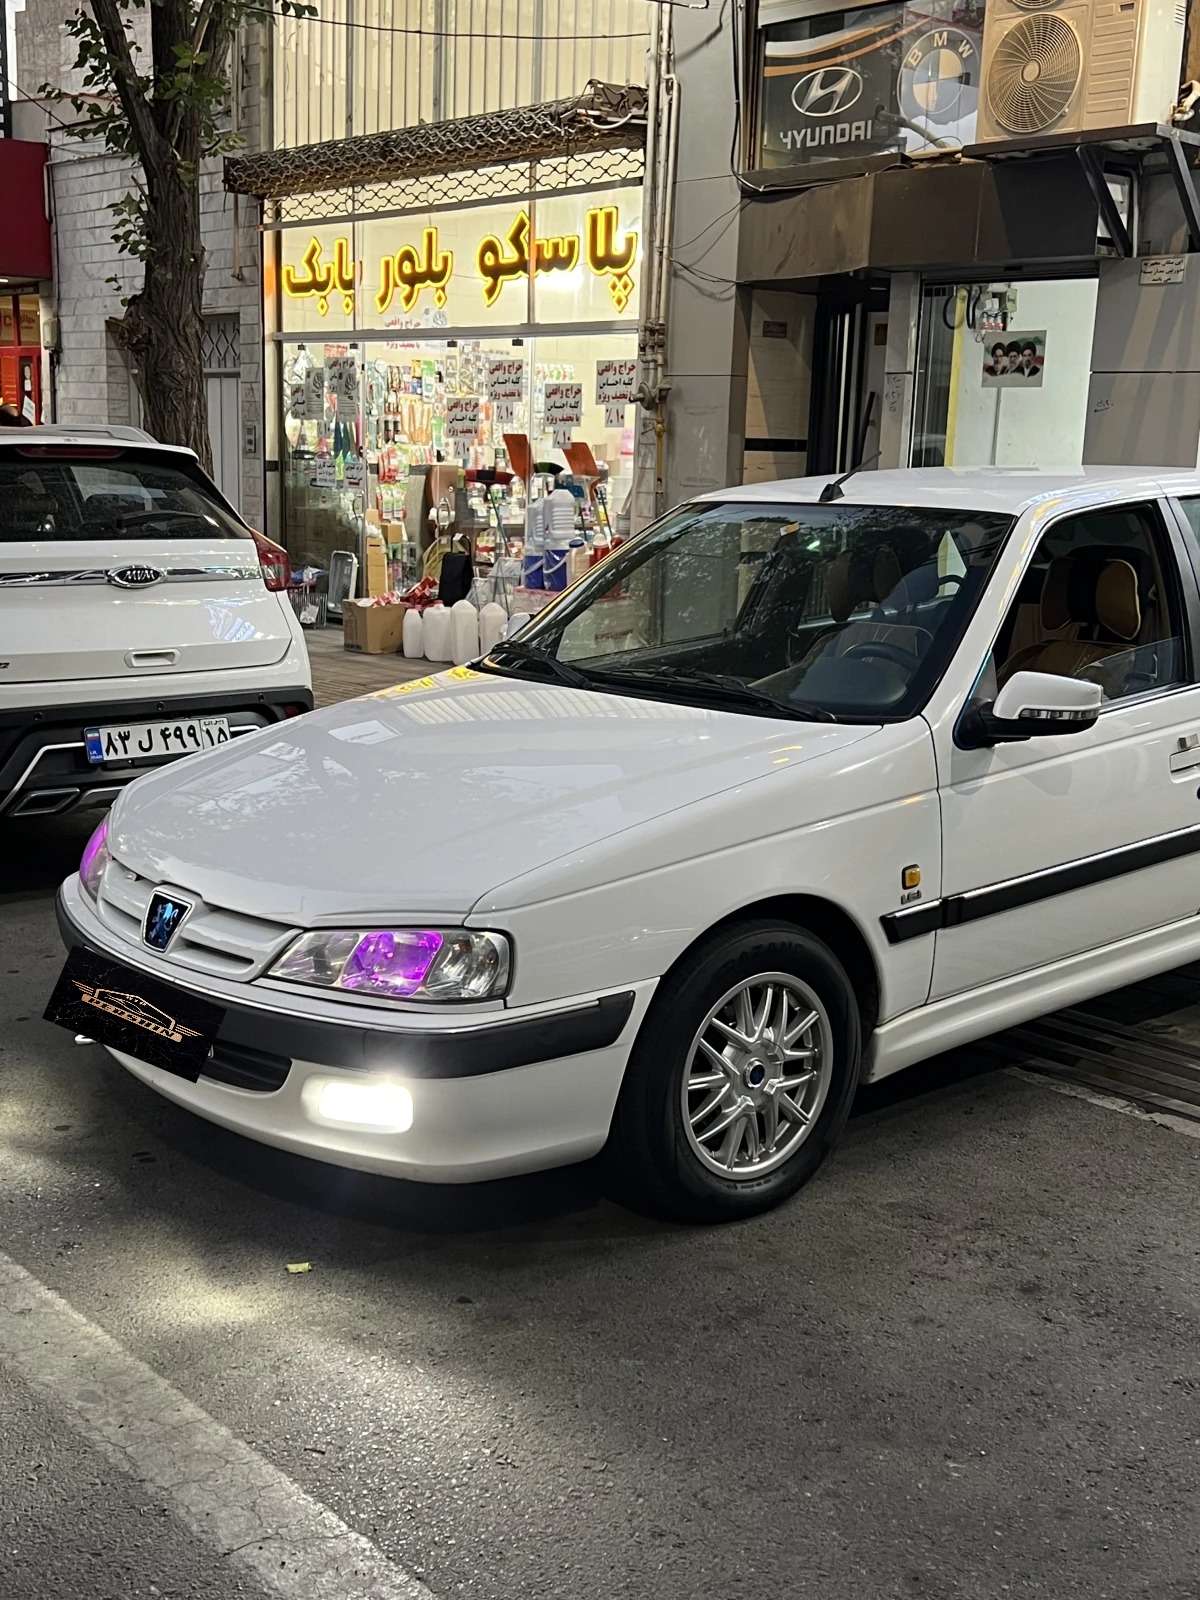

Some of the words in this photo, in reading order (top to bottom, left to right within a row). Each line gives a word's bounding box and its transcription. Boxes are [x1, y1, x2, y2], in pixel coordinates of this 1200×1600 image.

[779, 119, 873, 150] HYUNDAI
[476, 206, 638, 313] پلاسکو
[281, 236, 363, 316] بابک
[374, 226, 453, 314] بلور
[489, 361, 506, 375] واقعی
[507, 361, 523, 374] حراج
[597, 360, 617, 376] واقعی
[618, 361, 636, 375] حراج
[545, 384, 564, 399] واقعی
[565, 385, 582, 398] حراج
[447, 399, 464, 412] واقعی
[464, 399, 479, 412] حراج
[122, 569, 156, 581] MVM
[104, 730, 131, 756] ۸۳
[137, 728, 154, 752] ل
[159, 724, 201, 751] ۴۹۹
[205, 726, 229, 746] ۱۵
